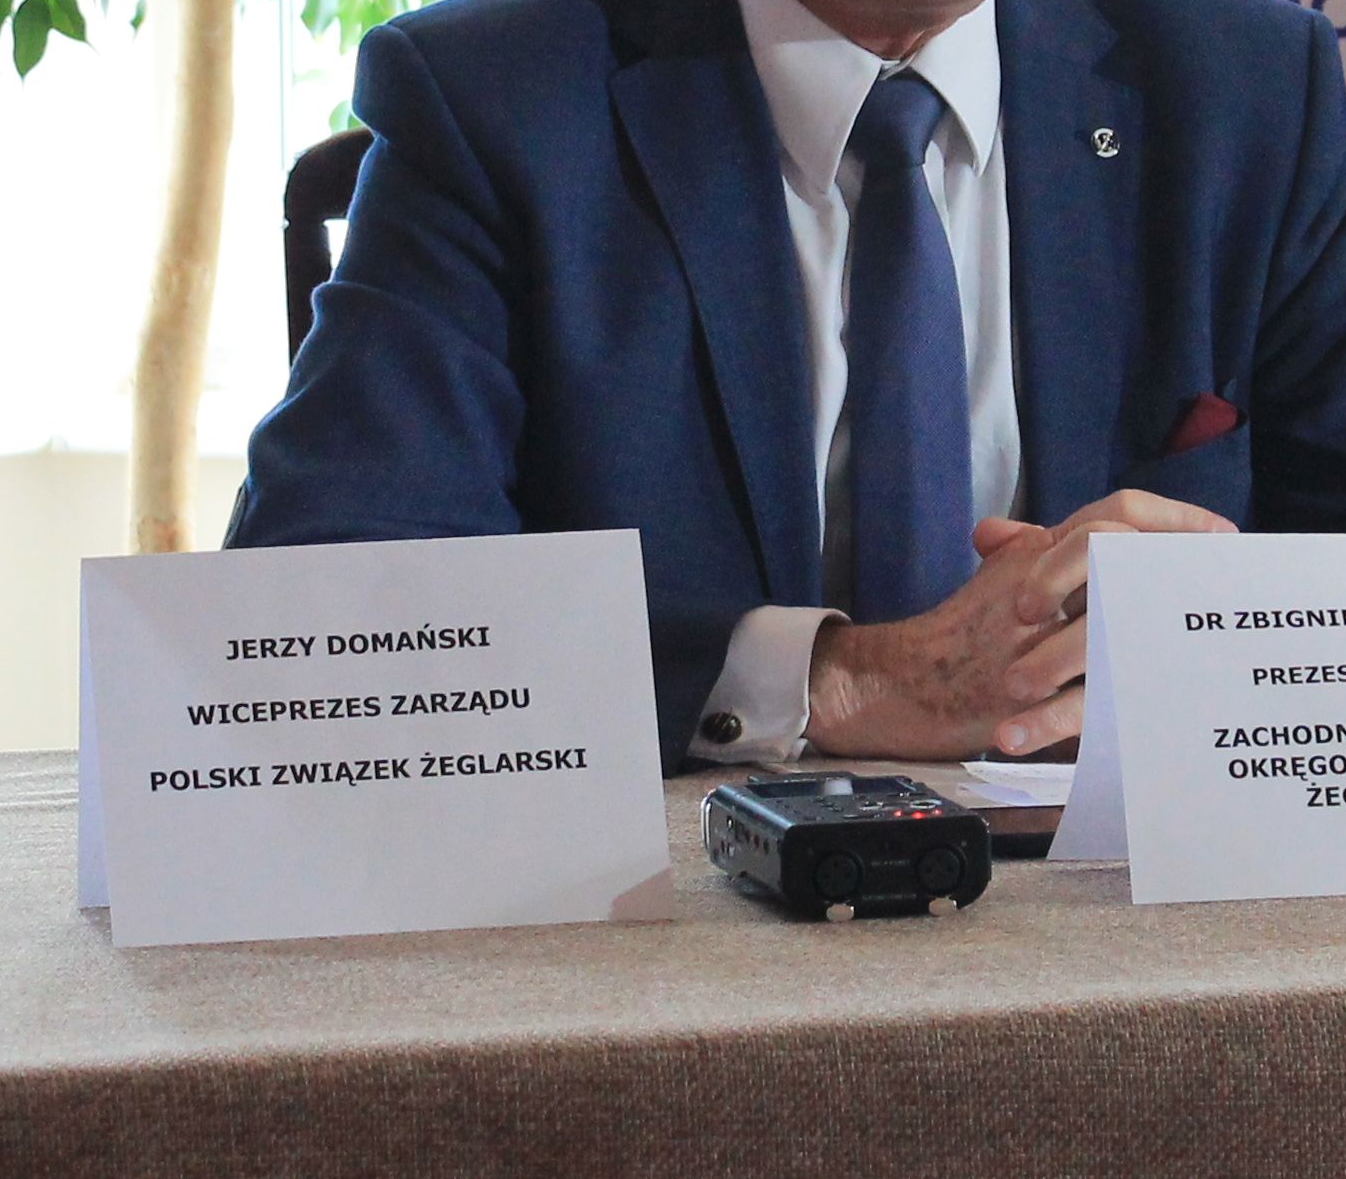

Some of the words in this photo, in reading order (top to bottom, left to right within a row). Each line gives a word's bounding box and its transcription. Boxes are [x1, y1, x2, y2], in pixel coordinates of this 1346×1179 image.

[1185, 611, 1225, 631] DR
[226, 635, 316, 661] JERZY
[327, 623, 491, 657] DOMAŃSKI
[187, 697, 381, 726] WICEPREZES
[391, 687, 531, 716] ZARZĄDU
[150, 768, 262, 792] POLSKI
[271, 757, 410, 787] ZWIĄZEK
[419, 748, 588, 778] ŻEGLARSKI
